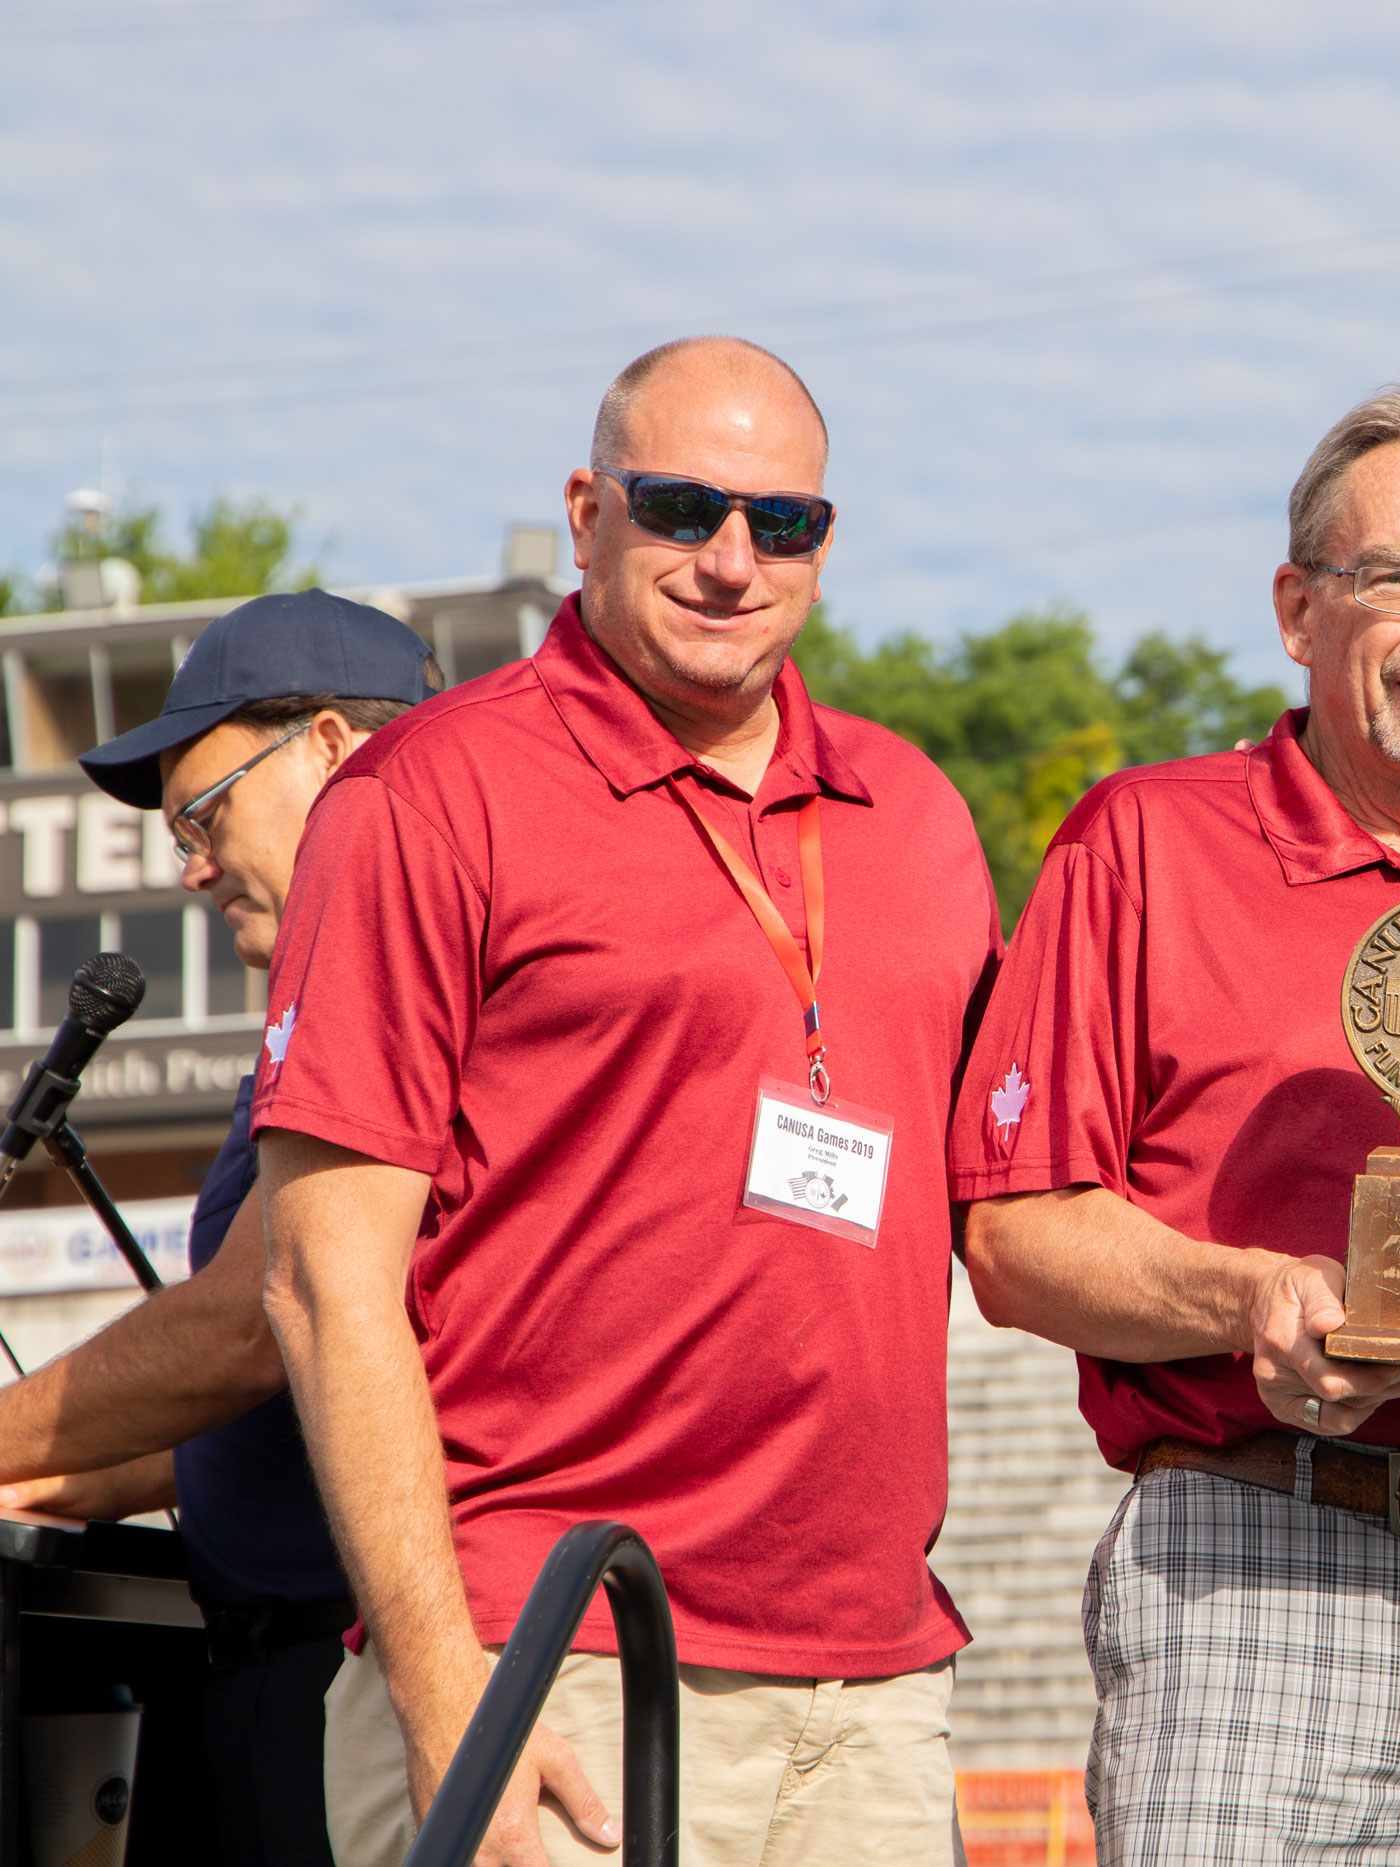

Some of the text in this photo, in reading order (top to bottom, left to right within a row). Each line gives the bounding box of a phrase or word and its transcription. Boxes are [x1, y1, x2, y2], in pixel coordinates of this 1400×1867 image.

[0, 793, 180, 897] TE
[777, 1114, 874, 1160] CANUSA Games 2019
